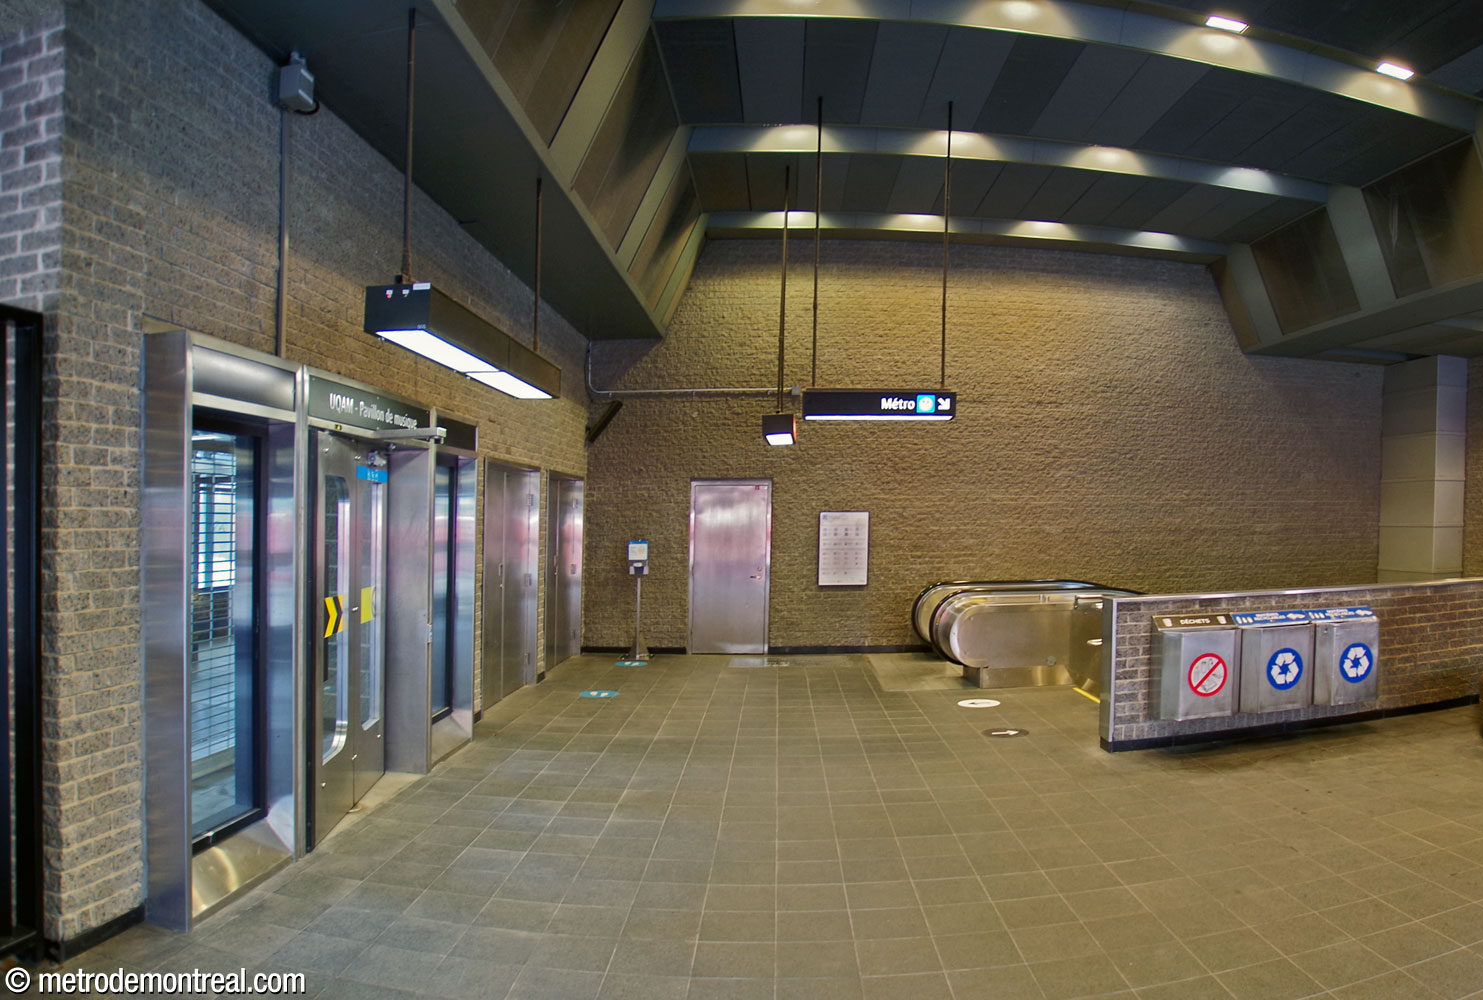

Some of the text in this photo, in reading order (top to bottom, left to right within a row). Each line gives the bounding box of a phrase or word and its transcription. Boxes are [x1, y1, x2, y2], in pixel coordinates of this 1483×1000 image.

[329, 392, 354, 414] UQAM
[359, 400, 385, 422] Pavillon
[385, 408, 393, 424] de
[393, 413, 418, 431] musique
[880, 397, 916, 410] Métro
